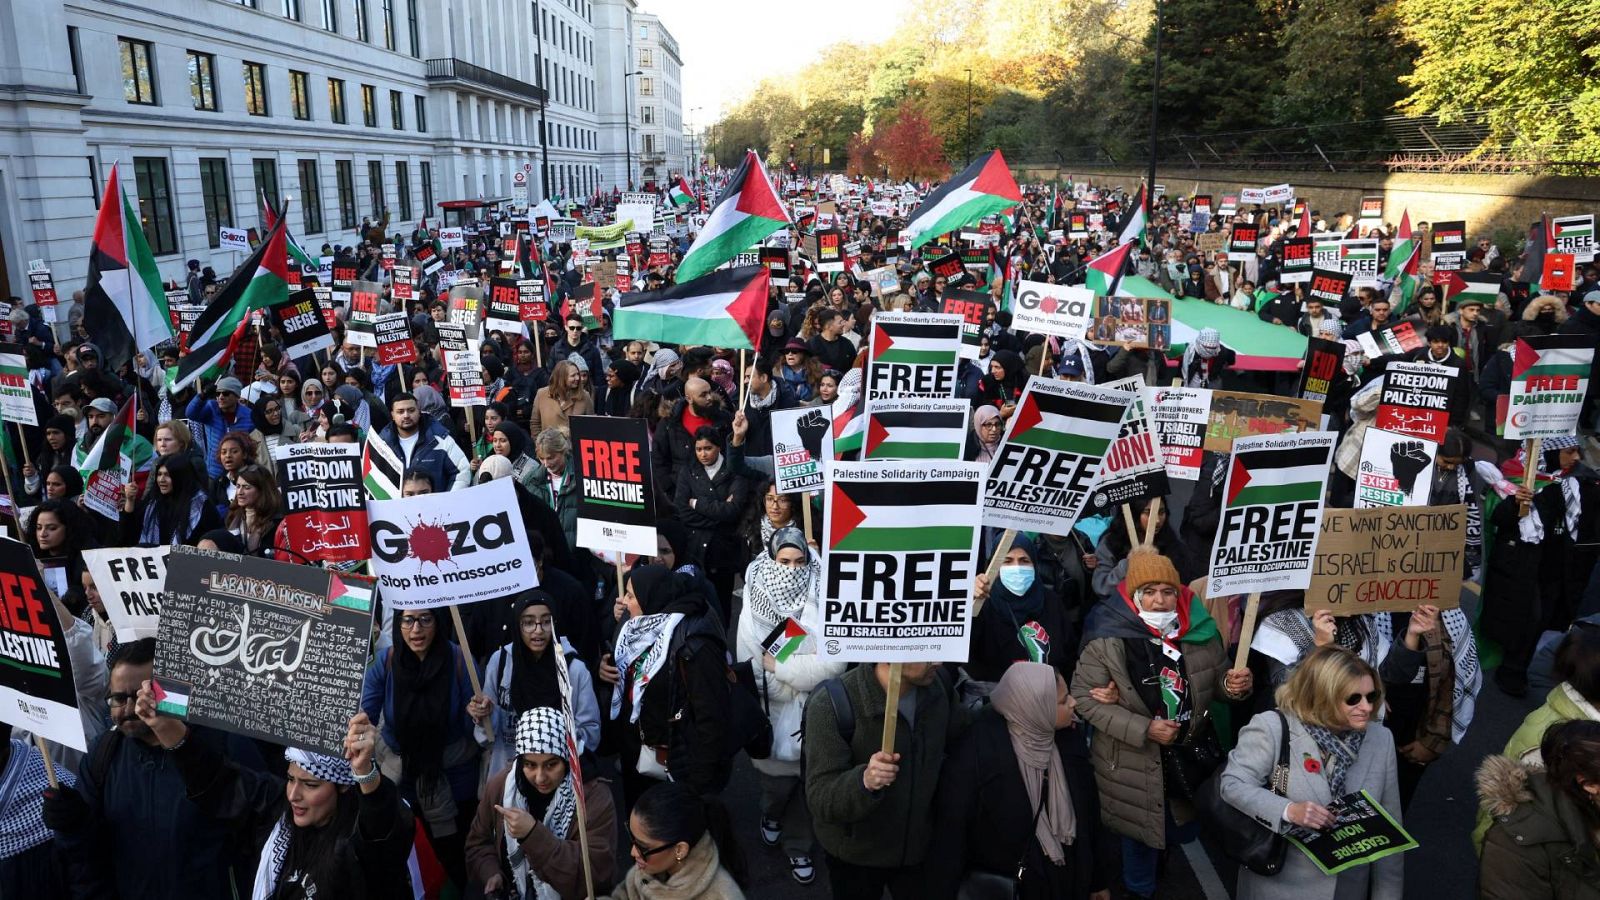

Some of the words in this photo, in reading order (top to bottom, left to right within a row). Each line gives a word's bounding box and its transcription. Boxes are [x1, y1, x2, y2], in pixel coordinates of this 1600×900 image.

[1235, 230, 1257, 241] FREE
[1557, 236, 1592, 248] FREE
[1284, 244, 1311, 259] FREE
[334, 268, 357, 279] FREE
[1341, 260, 1376, 271] FREE
[1313, 276, 1346, 294] FREE
[296, 301, 314, 315] THE
[353, 291, 378, 313] FREE
[451, 309, 476, 326] SIEGE
[944, 298, 984, 323] FREE
[283, 312, 318, 333] SIEGE
[376, 320, 405, 332] FREEDOM
[876, 315, 901, 323] Palestine
[1016, 313, 1033, 323] Stop
[1034, 315, 1045, 324] the
[1047, 319, 1082, 329] massacre
[376, 331, 410, 343] PALESTINE
[1396, 364, 1424, 372] Socialist
[870, 363, 954, 393] FREE
[1390, 372, 1447, 390] FREEDOM
[1525, 375, 1581, 393] FREE
[1032, 381, 1063, 396] Palestine
[1065, 387, 1098, 400] Solidarity
[1100, 394, 1130, 404] Campaign
[1384, 390, 1448, 409] PALESTINE
[1513, 393, 1584, 405] PALESTINE
[900, 403, 931, 411] Solidarity
[1391, 408, 1432, 423] الحرية
[1163, 423, 1198, 434] ISRAELI
[1166, 435, 1201, 446] TERROR
[1236, 441, 1263, 451] Palestine
[1265, 439, 1296, 449] Solidarity
[1298, 438, 1331, 447] Campaign
[289, 447, 319, 456] Socialist
[319, 447, 347, 456] Worker
[778, 452, 810, 465] EXIST.
[1106, 433, 1155, 472] URN!
[579, 439, 642, 482] FREE
[990, 444, 1102, 493] FREE
[287, 460, 353, 481] FREEDOM
[780, 463, 817, 478] RESIST.
[833, 469, 878, 479] Palestine
[881, 469, 928, 481] Solidarity
[931, 469, 980, 481] Campaign
[781, 474, 823, 489] RETURN.
[1108, 482, 1143, 493] PALESTINE
[288, 488, 360, 509] PALESTINE
[583, 479, 644, 503] PALESTINE
[985, 479, 1086, 508] PALESTINE
[1109, 485, 1148, 498] SOLIDARITY
[1110, 490, 1145, 502] CAMPAIGN
[984, 499, 994, 507] ND
[996, 501, 1027, 512] ISRAELI
[1028, 506, 1074, 517] OCCUPATION
[305, 515, 350, 534] الحرية
[1219, 502, 1319, 547] FREE
[1350, 516, 1382, 533] WANT
[1386, 512, 1459, 531] SANCTIONS
[1372, 534, 1410, 550] NOW
[171, 545, 197, 556] GLOBAL
[218, 552, 243, 562] JOURNEY
[1214, 541, 1312, 565] PALESTINE
[1214, 567, 1228, 577] END
[1231, 564, 1259, 574] ISRAELI
[1261, 561, 1307, 572] OCCUPATION
[1314, 552, 1384, 576] ISRAEL
[1388, 557, 1395, 571] is
[1400, 550, 1460, 573] GUILTY
[381, 574, 410, 590] Stop
[413, 572, 439, 587] the
[442, 559, 522, 583] massacre
[826, 552, 971, 600] FREE
[261, 583, 277, 600] YA
[280, 588, 322, 611] HUSSEIN
[428, 596, 455, 604] Coalition
[458, 583, 520, 600] www.stopwar.org.uk
[1328, 582, 1351, 603] OF
[1356, 579, 1440, 602] GENOCIDE
[825, 601, 967, 624] PALESTINE
[316, 623, 337, 632] STOP
[338, 625, 356, 635] THE
[826, 626, 848, 637] END
[852, 627, 894, 637] ISRAELI
[897, 626, 963, 637] OCCUPATION
[308, 639, 334, 650] KILLING
[330, 634, 351, 644] STOP
[846, 643, 941, 651] www.palestinecampaign.org
[0, 629, 60, 668] LESTINE
[1332, 835, 1390, 860] CEASEFIRE
